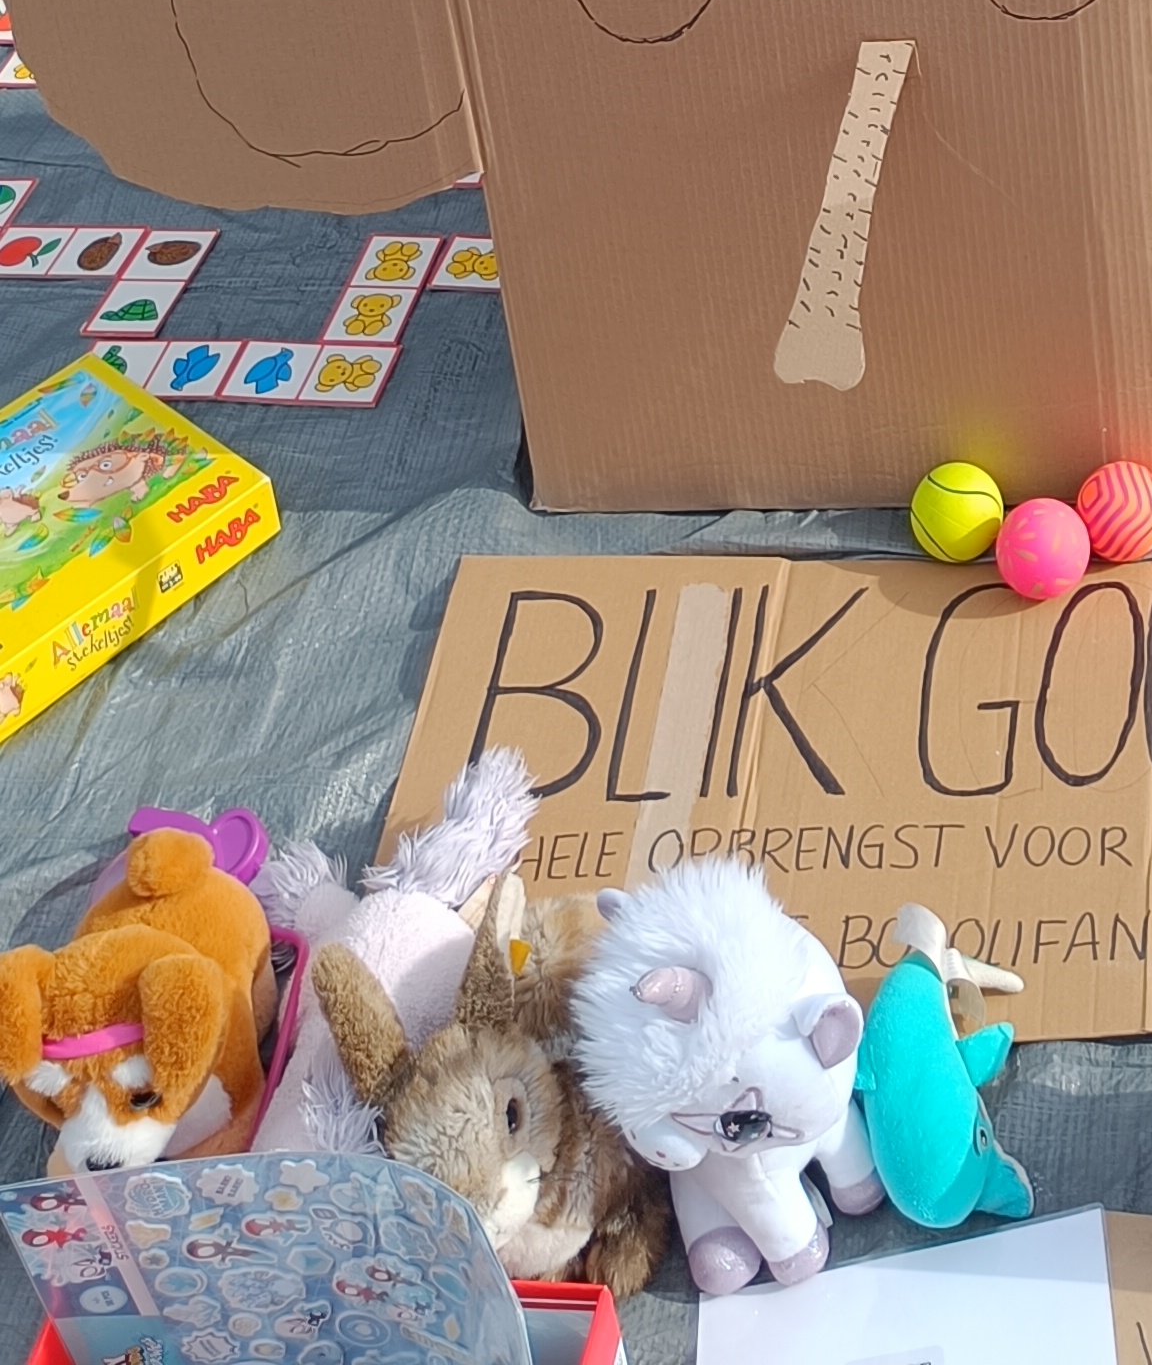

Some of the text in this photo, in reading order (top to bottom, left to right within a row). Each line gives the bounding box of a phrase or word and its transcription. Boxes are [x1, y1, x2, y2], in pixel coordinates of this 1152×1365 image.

[167, 474, 240, 523] HABA
[195, 508, 261, 565] HABA
[51, 587, 140, 669] Allemaal
[466, 586, 868, 802] BLIK
[522, 831, 624, 882] HELE
[648, 823, 966, 875] OPBRENGST
[985, 823, 1133, 868] VOOR
